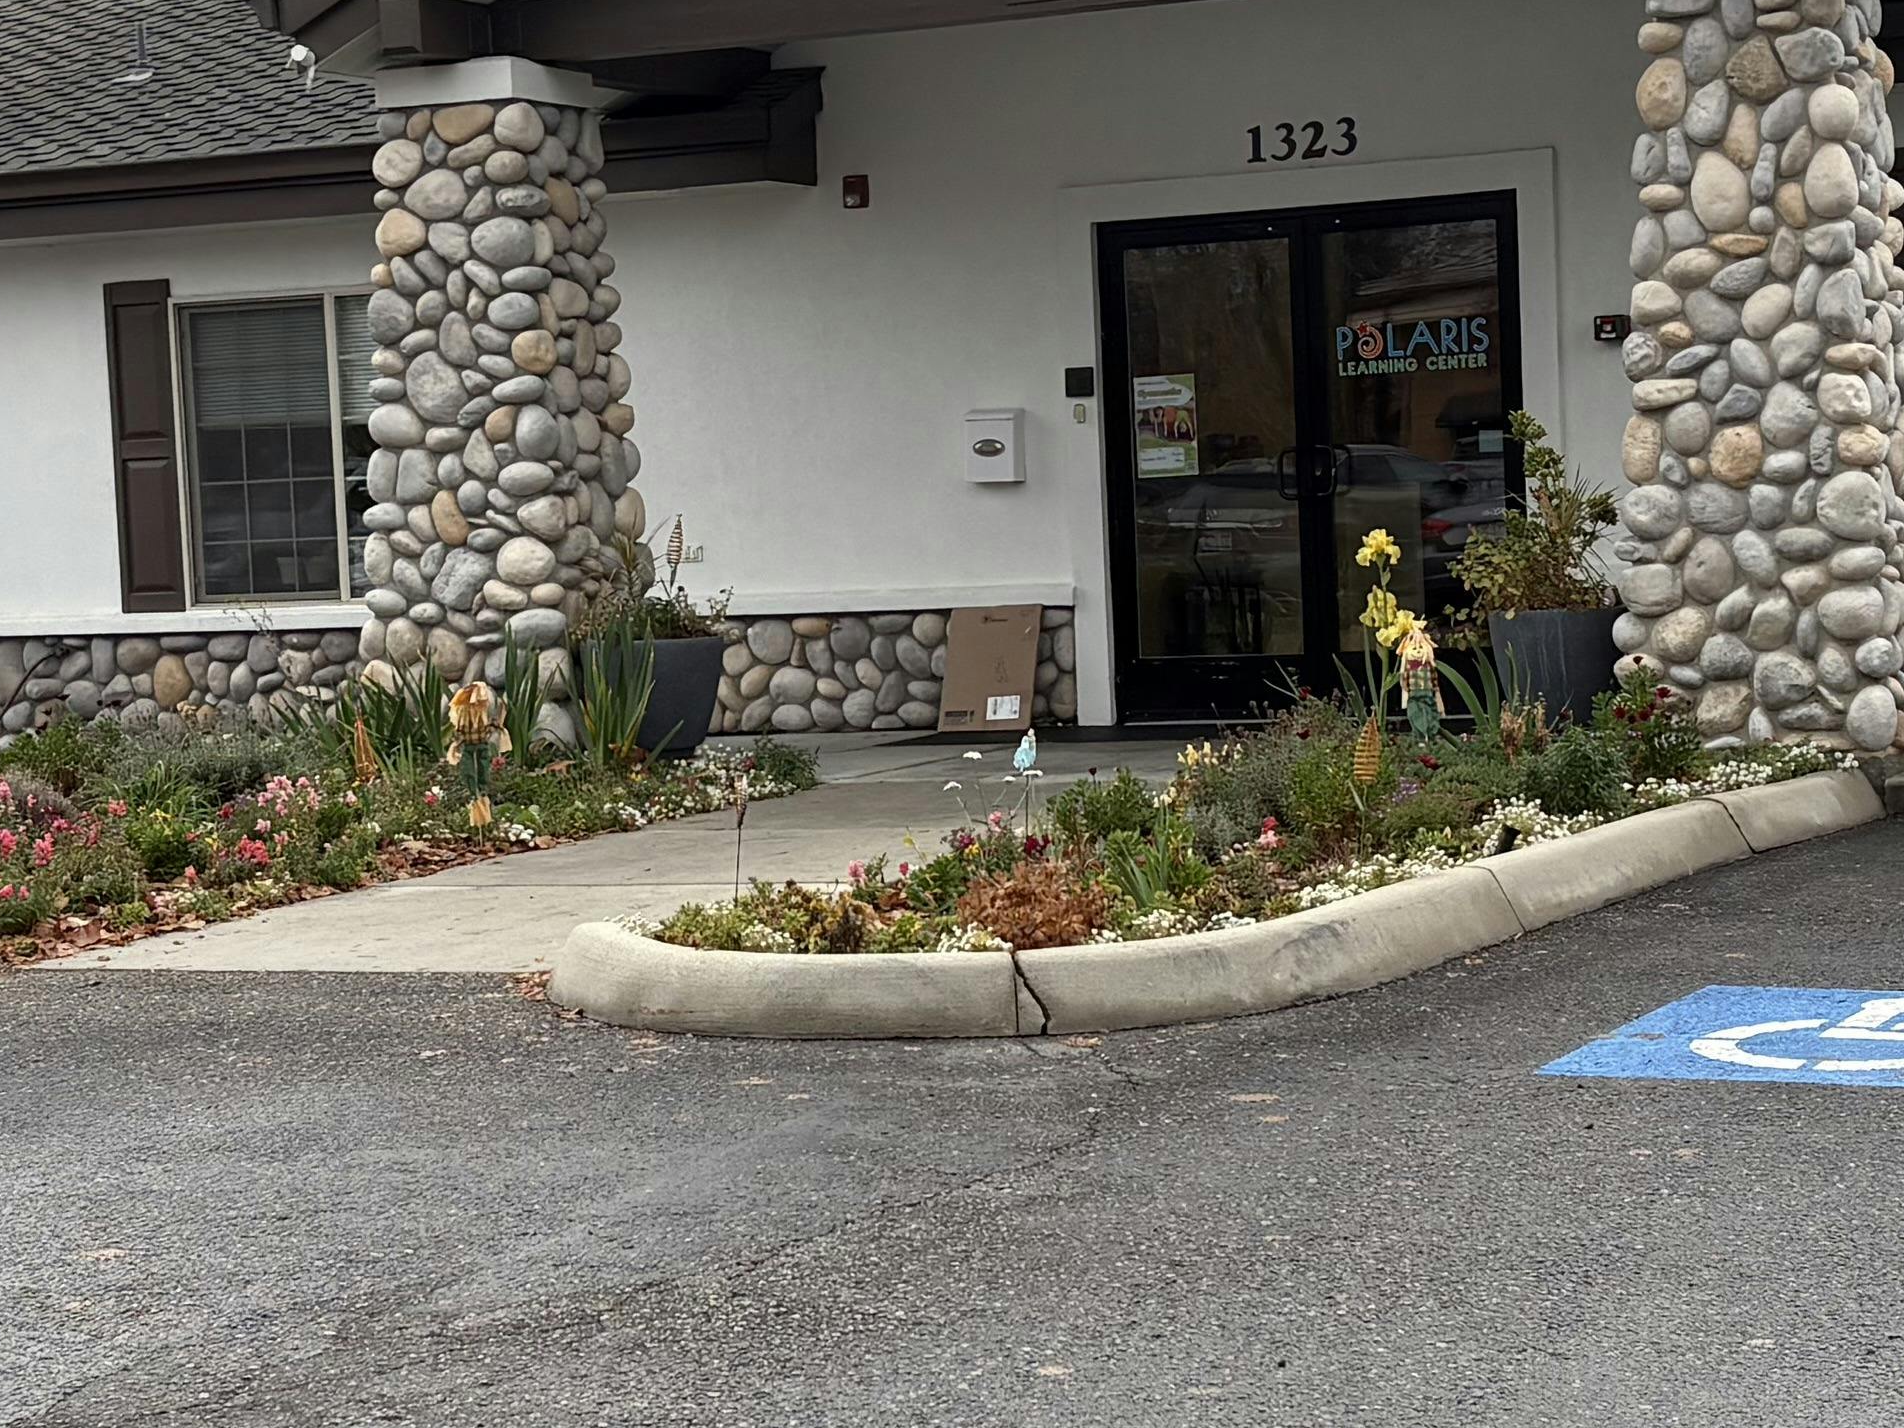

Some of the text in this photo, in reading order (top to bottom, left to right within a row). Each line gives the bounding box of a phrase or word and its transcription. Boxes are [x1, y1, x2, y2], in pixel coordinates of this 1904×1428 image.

[1246, 117, 1358, 163] 1323
[1336, 316, 1490, 360] POLARIS
[1338, 352, 1488, 377] LEARNING CENTER
